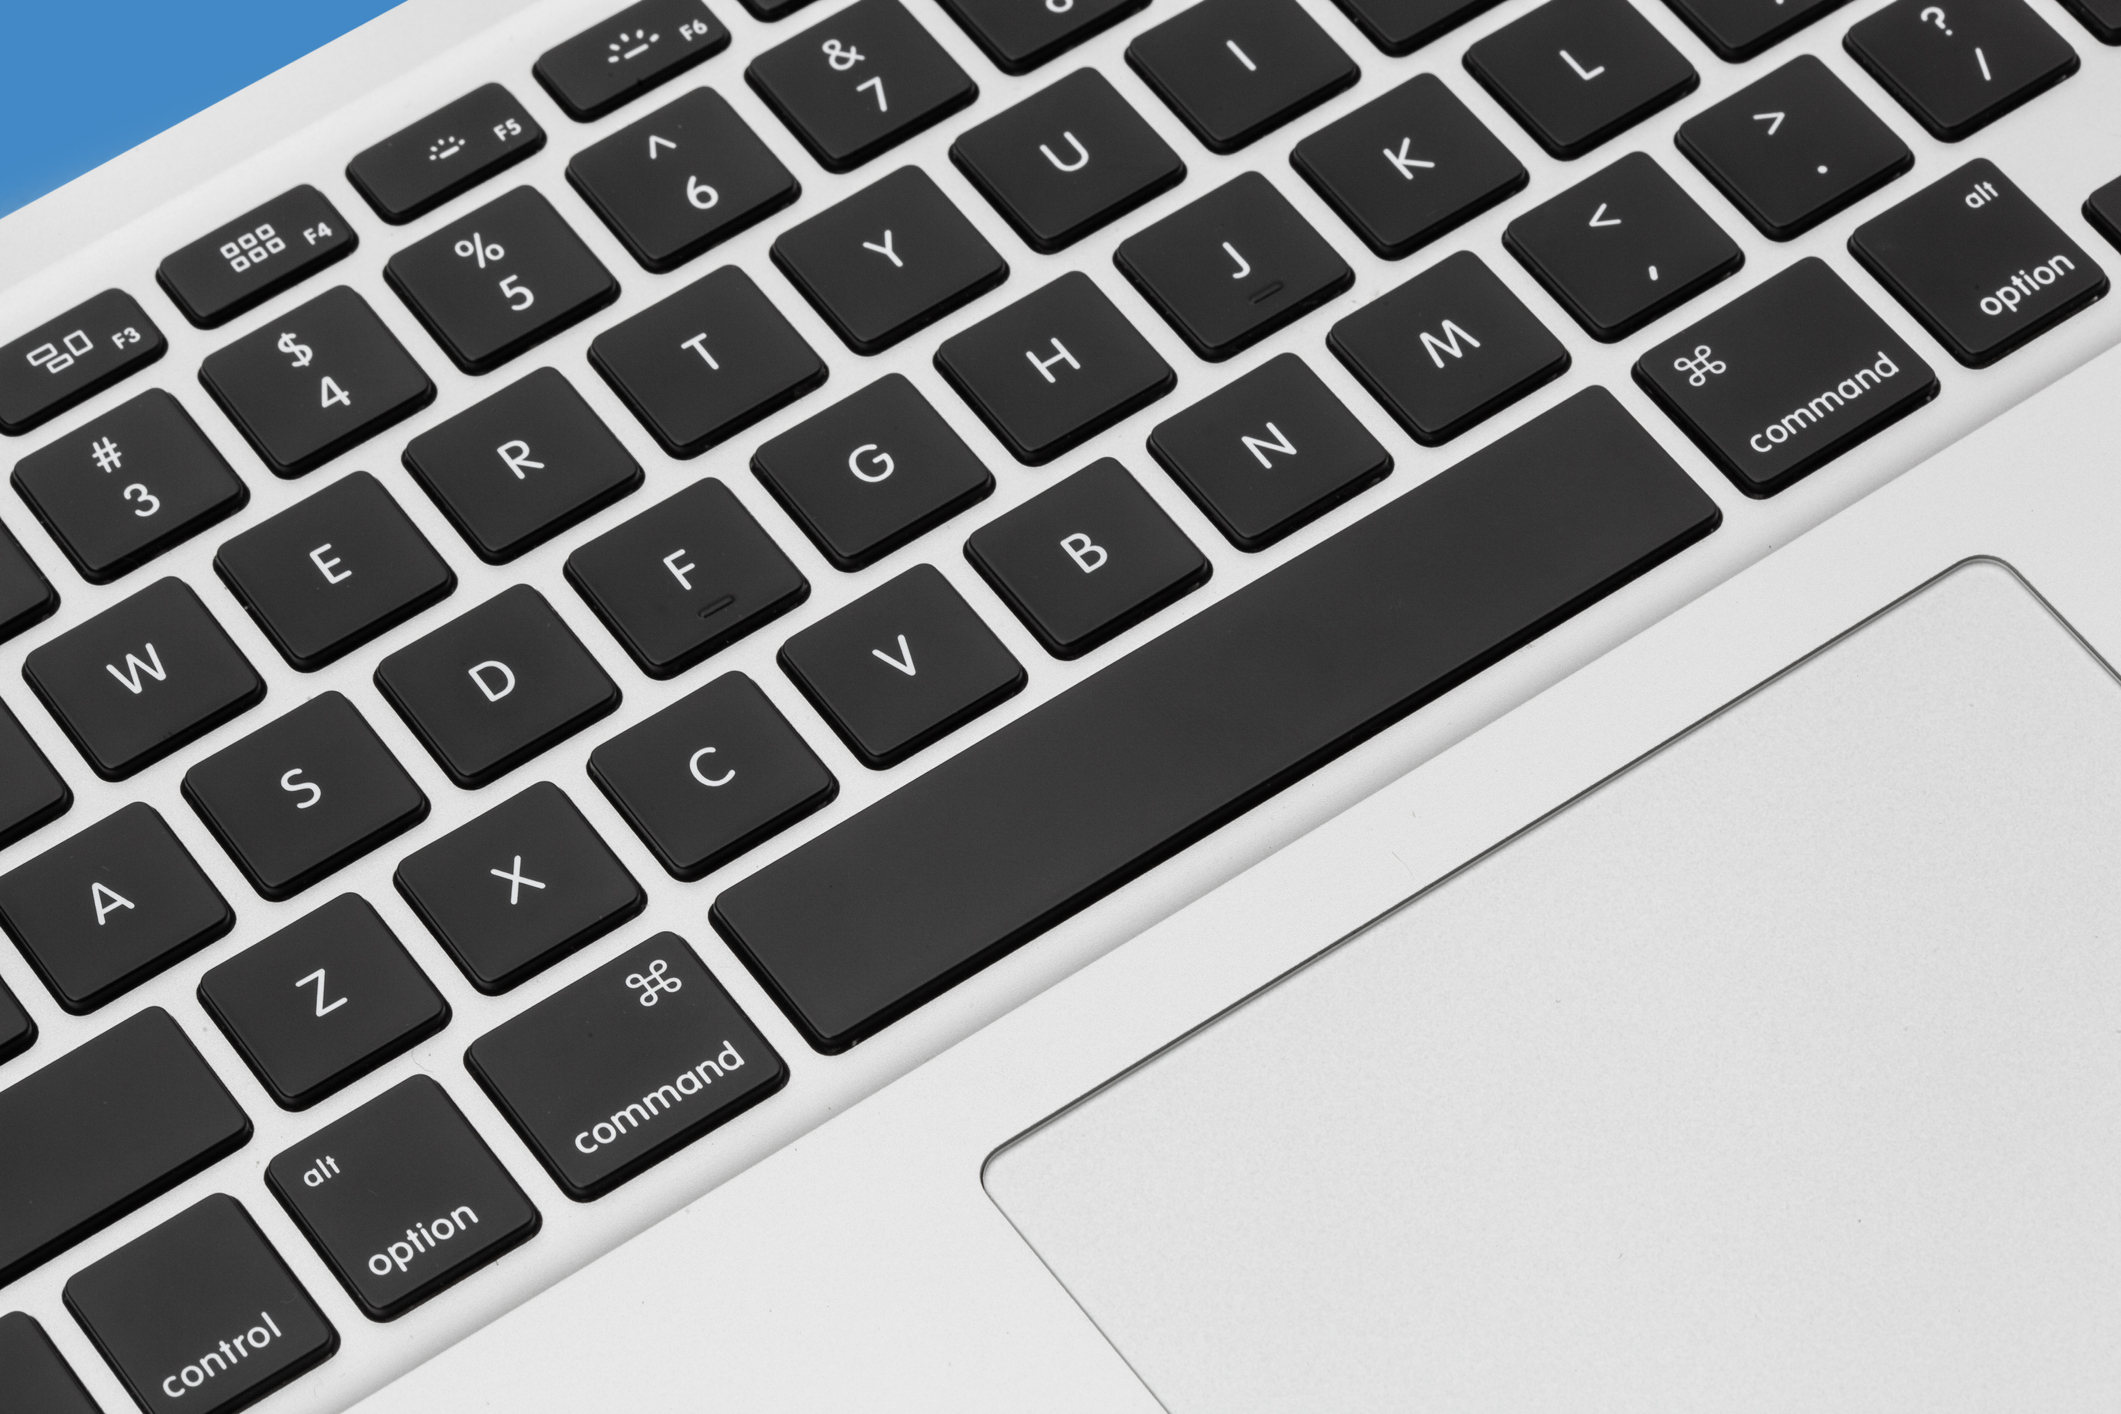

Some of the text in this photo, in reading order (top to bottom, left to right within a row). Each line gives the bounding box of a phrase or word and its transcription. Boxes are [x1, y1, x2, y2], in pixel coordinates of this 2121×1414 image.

[678, 19, 708, 42] F6
[1920, 6, 1953, 36] ?
[821, 38, 866, 71] &
[1226, 39, 1257, 72] I
[1559, 49, 1605, 81] L
[855, 76, 888, 113] 7
[492, 118, 522, 142] F5
[1039, 131, 1090, 172] U
[1382, 136, 1436, 180] K
[686, 175, 719, 210] 6
[1964, 181, 1999, 209] alt
[302, 221, 333, 246] F4
[454, 231, 505, 269] %
[862, 229, 904, 268] Y
[1222, 241, 1251, 280] J
[498, 274, 535, 311] 5
[1979, 254, 2076, 316] option
[111, 326, 141, 350] F3
[277, 332, 314, 368] $
[680, 332, 720, 371] T
[1419, 319, 1481, 369] M
[1025, 337, 1081, 384] H
[320, 375, 352, 409] 4
[1749, 350, 1900, 453] command
[91, 436, 122, 474] #
[496, 439, 545, 480] R
[848, 443, 895, 483] G
[1240, 421, 1298, 470] N
[123, 482, 161, 518] 3
[309, 542, 353, 585] E
[662, 548, 696, 591] F
[1059, 532, 1108, 574] B
[105, 642, 167, 695] W
[871, 634, 917, 677] V
[467, 660, 516, 703] D
[689, 746, 736, 787] C
[280, 767, 322, 809] S
[490, 854, 546, 906] X
[91, 881, 136, 926] A
[294, 968, 348, 1018] Z
[574, 1039, 746, 1154] command
[303, 1155, 341, 1188] alt
[368, 1205, 479, 1279] option
[162, 1311, 282, 1398] control
